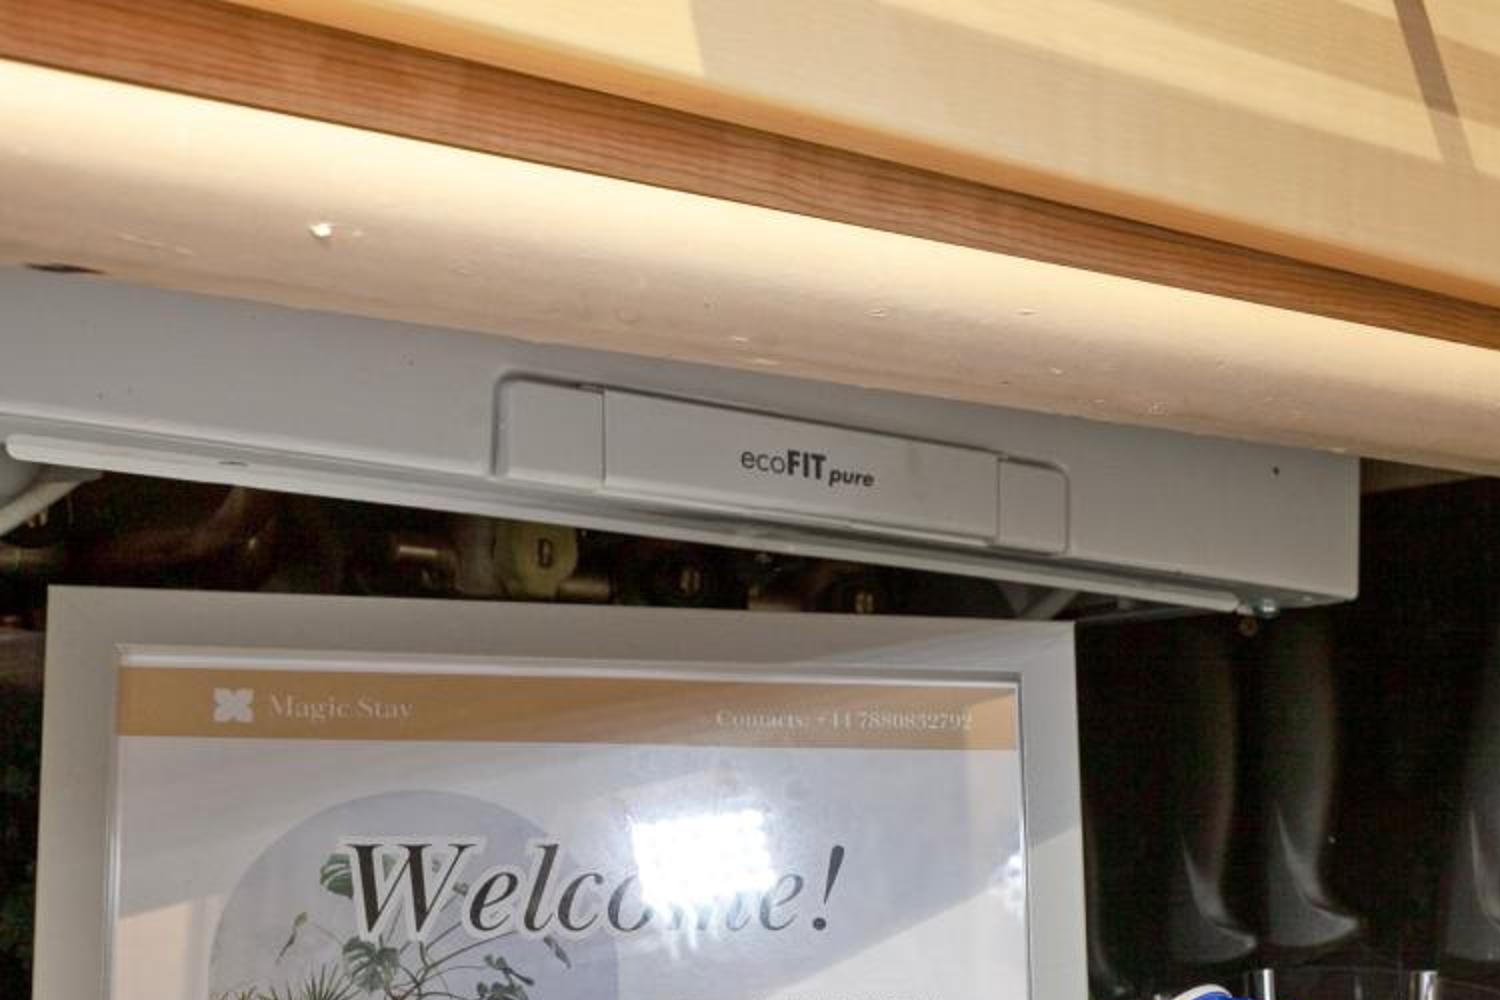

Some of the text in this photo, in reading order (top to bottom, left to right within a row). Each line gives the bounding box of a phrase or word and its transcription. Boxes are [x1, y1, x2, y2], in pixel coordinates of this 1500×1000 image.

[741, 449, 875, 488] ecoFIT pure
[269, 693, 415, 724] Magic Stay
